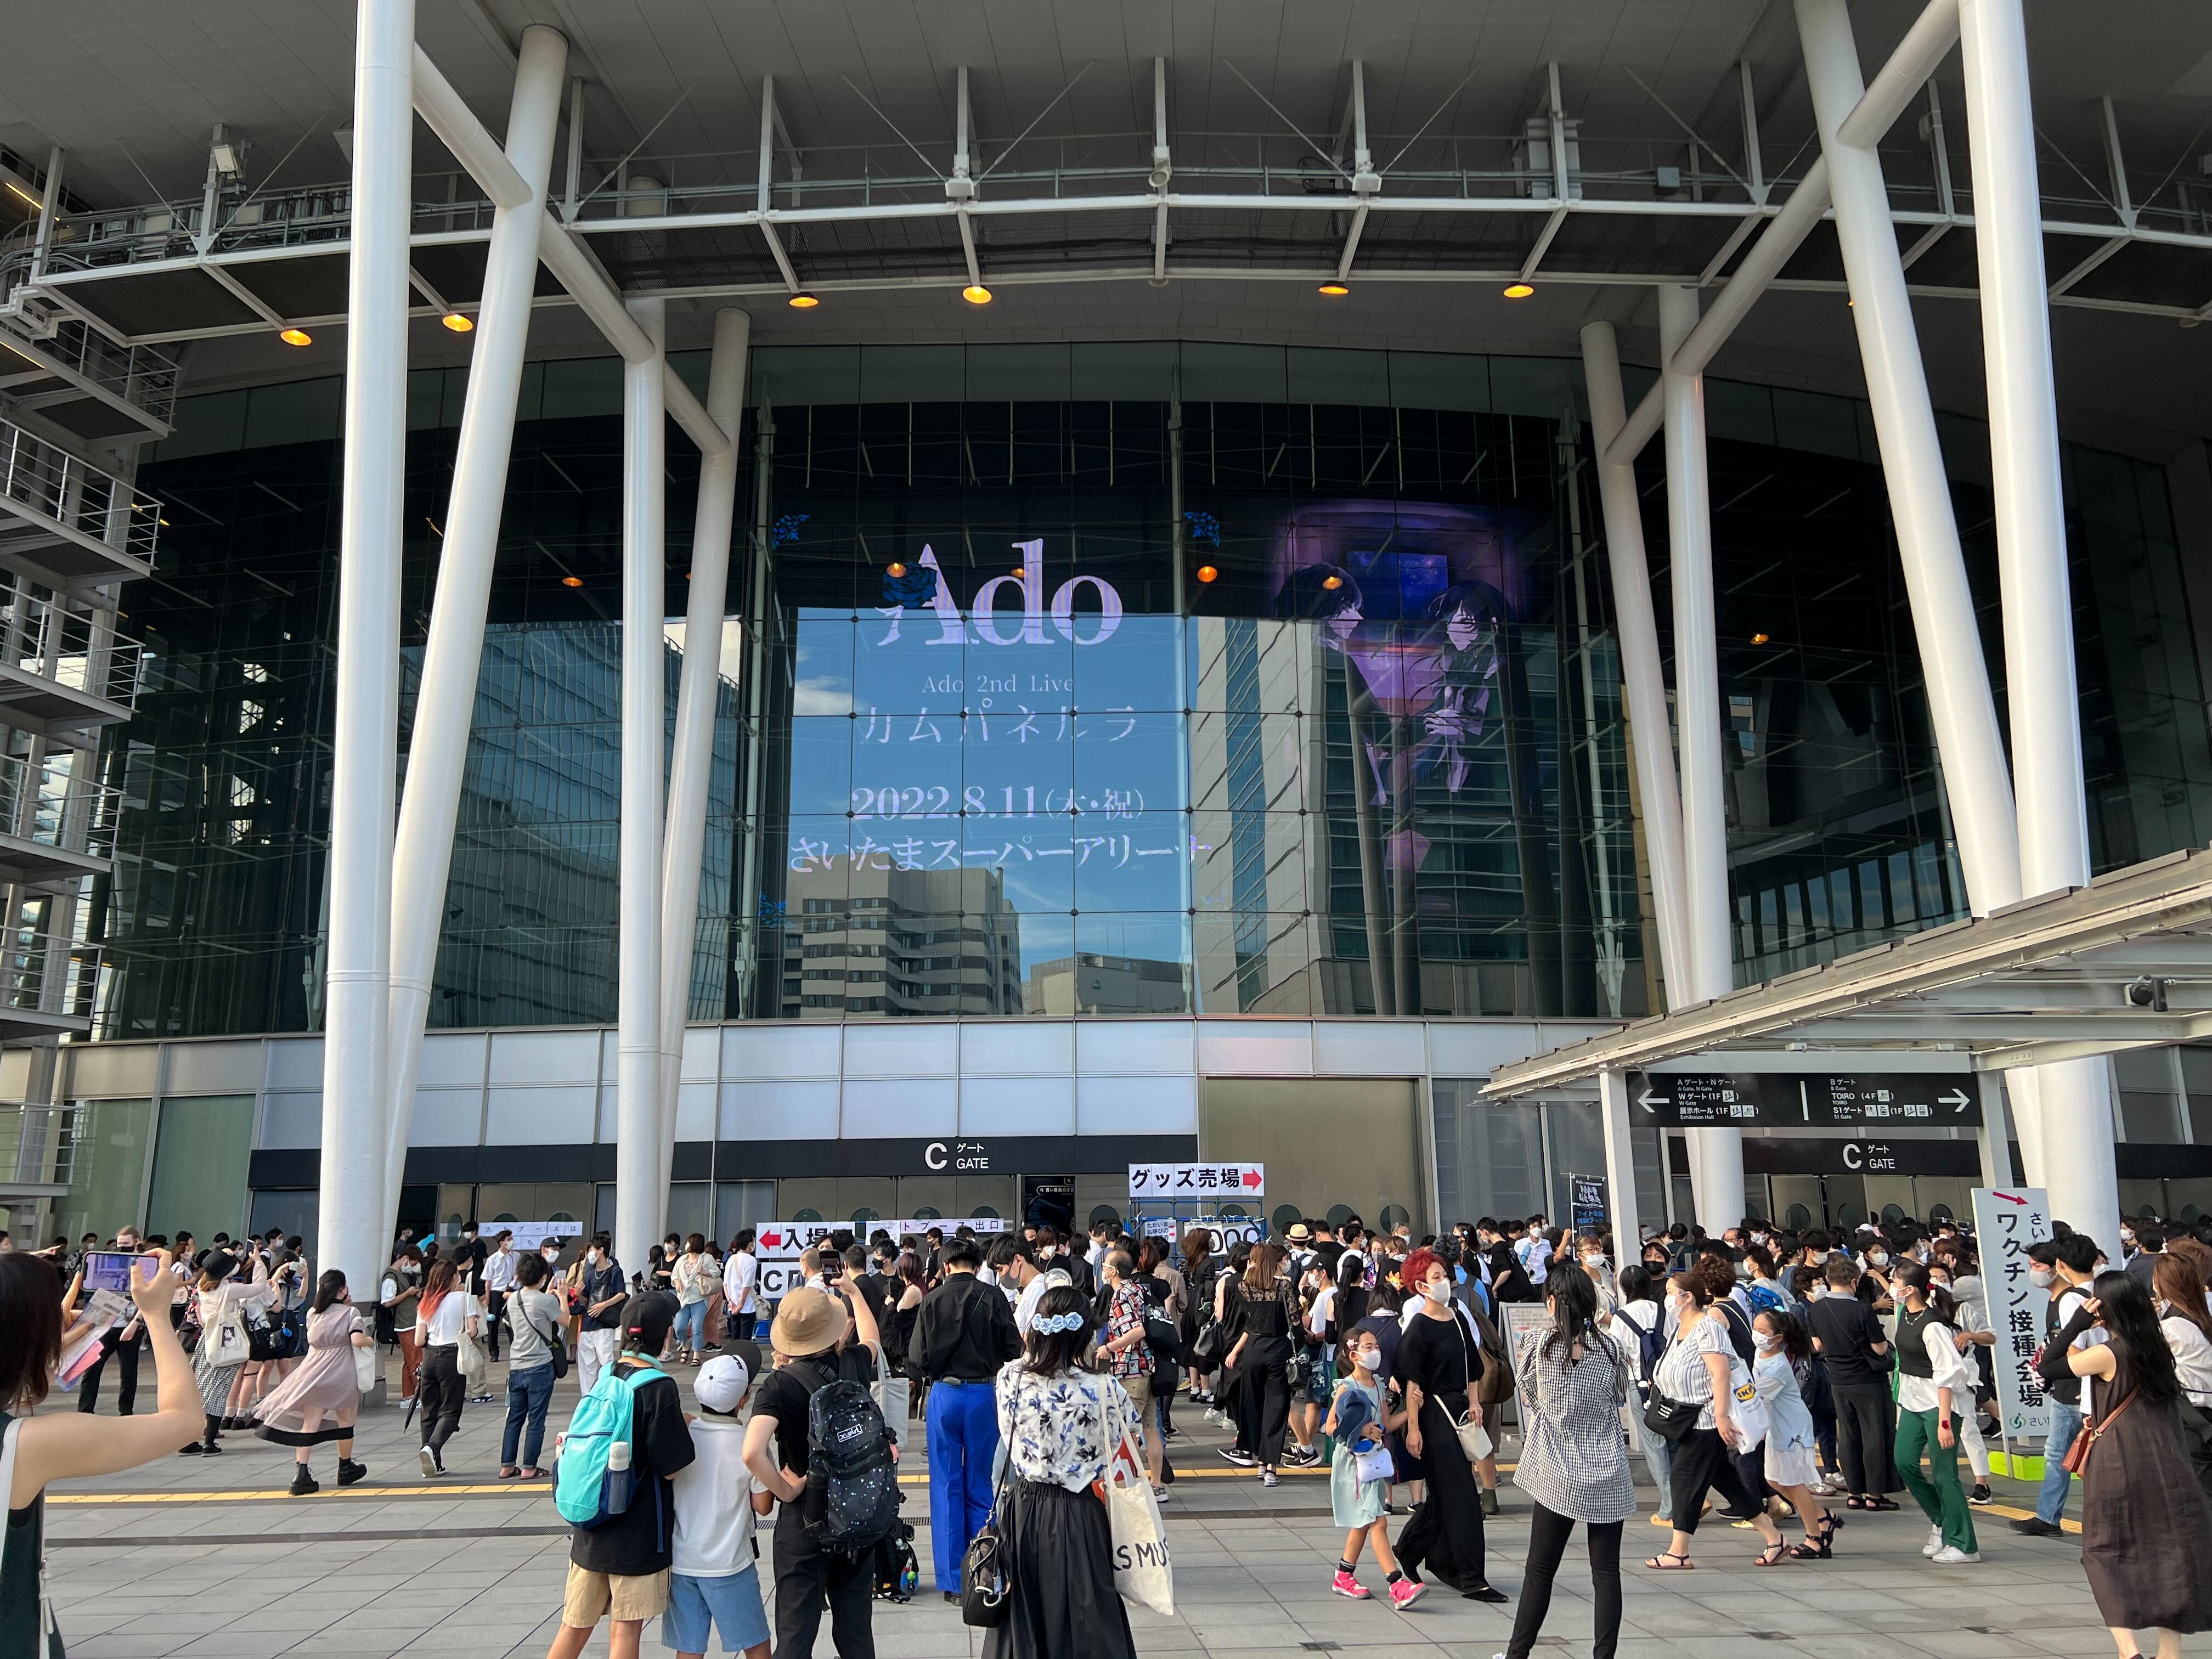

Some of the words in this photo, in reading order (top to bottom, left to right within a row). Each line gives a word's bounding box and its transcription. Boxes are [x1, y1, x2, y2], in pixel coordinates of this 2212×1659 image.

[874, 537, 1123, 645] Ado
[922, 675, 964, 693] Ado
[977, 674, 1017, 693] 2nd
[1030, 674, 1074, 692] Live
[860, 697, 1137, 744] カムパネルラ
[791, 834, 1212, 873] さいたまスーパーアリーナ
[925, 1142, 947, 1170] C
[957, 1143, 984, 1153] ゲート
[1843, 1143, 1862, 1169] C
[1867, 1144, 1890, 1154] ゲート
[956, 1158, 989, 1169] GATE
[1869, 1158, 1896, 1169] GATE
[1131, 1168, 1240, 1189] グッズ売場
[2030, 1212, 2045, 1238] さい
[782, 1228, 853, 1251] 入場
[1997, 1214, 2043, 1407] ワクチン接種会場
[1113, 1544, 1132, 1571] S
